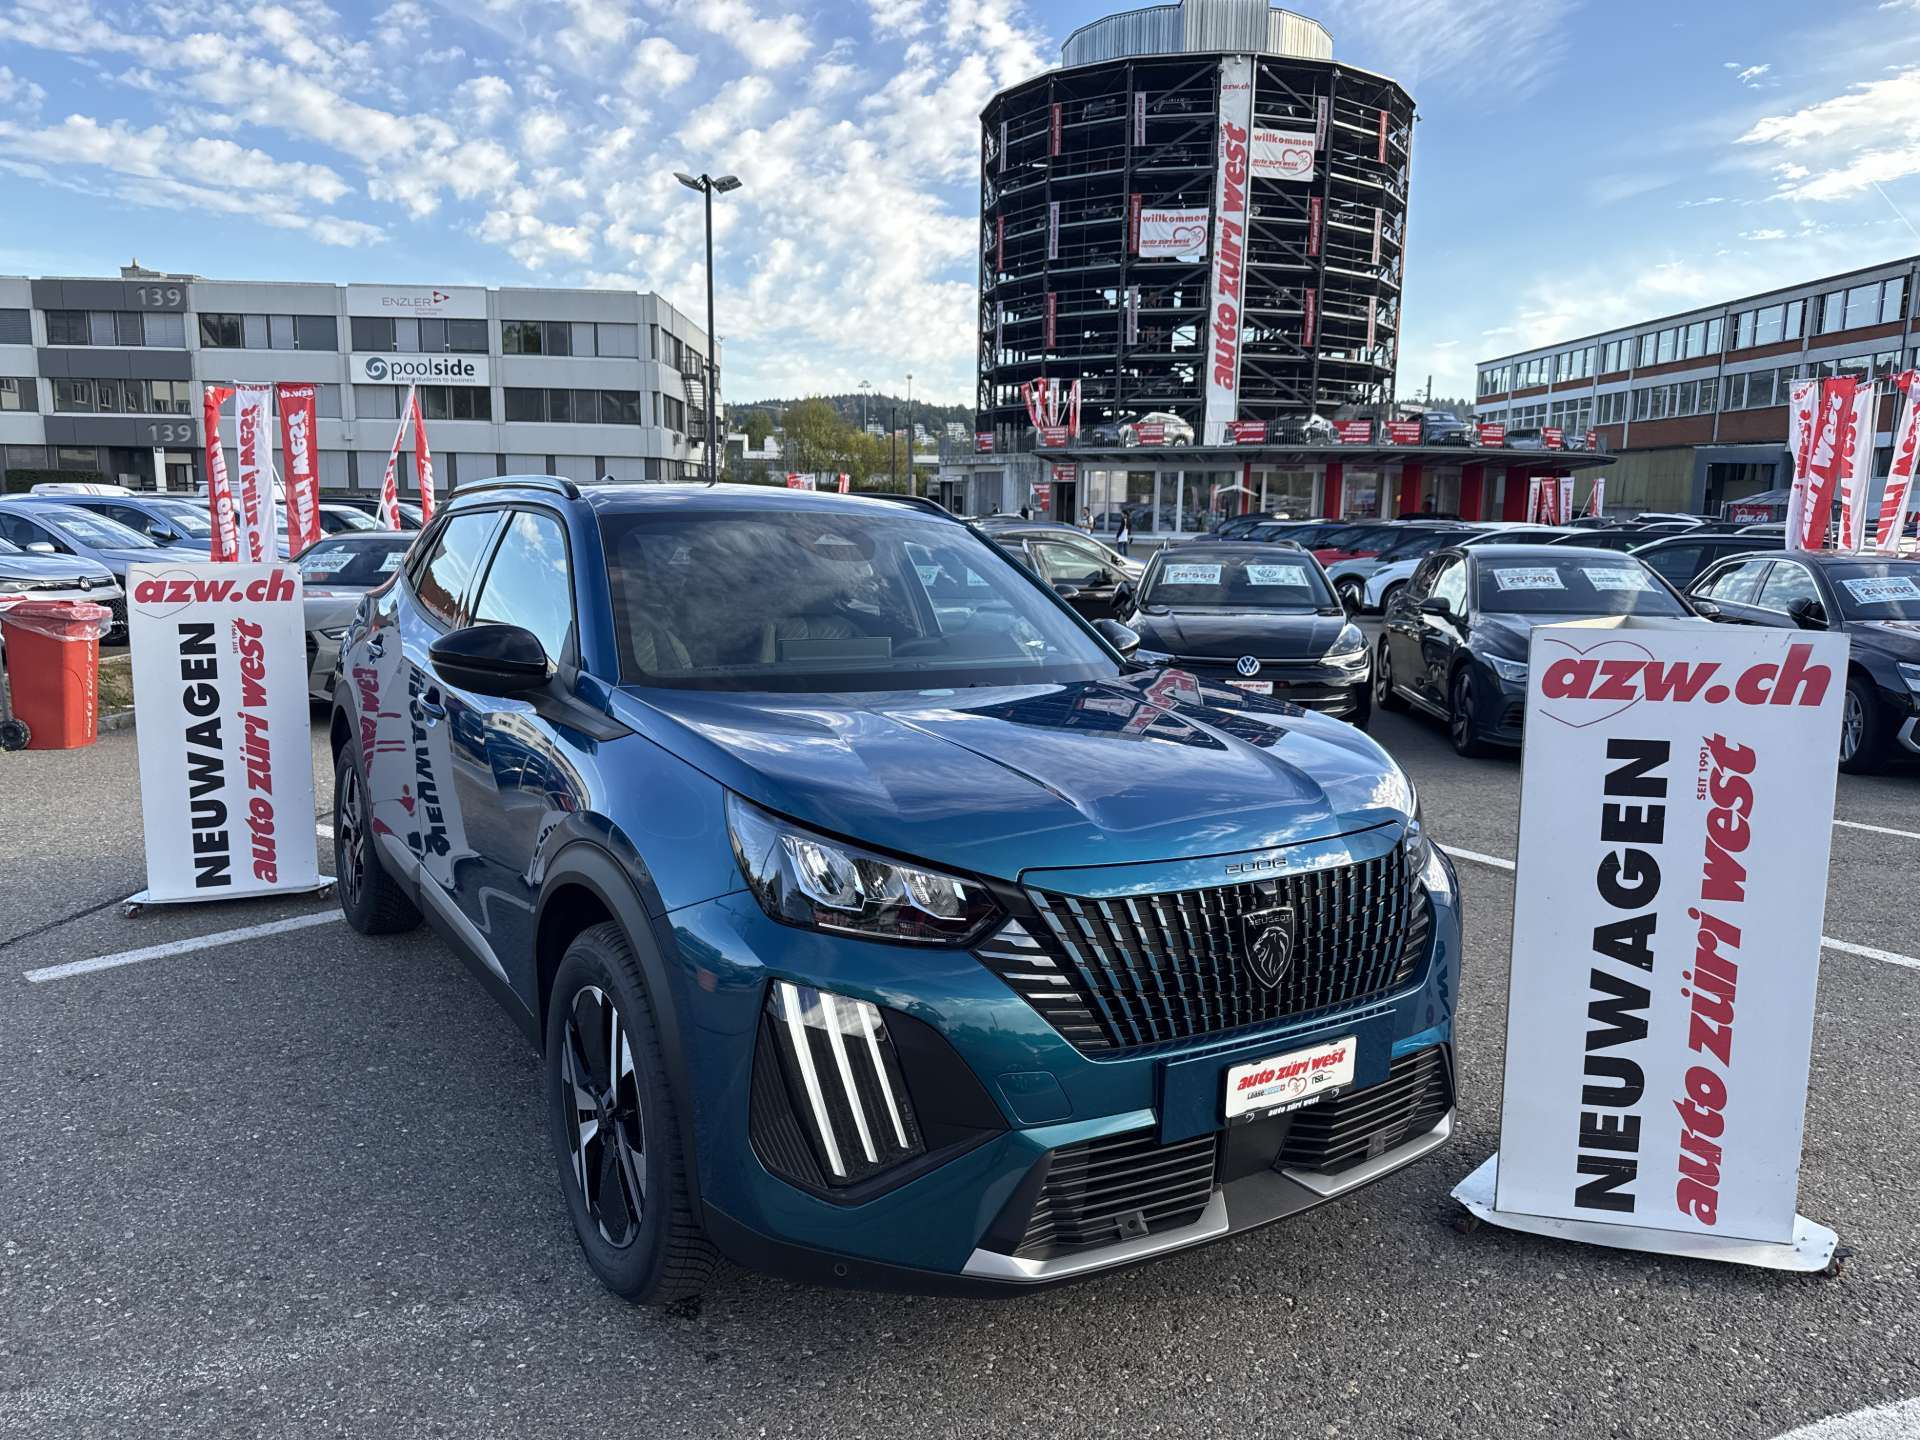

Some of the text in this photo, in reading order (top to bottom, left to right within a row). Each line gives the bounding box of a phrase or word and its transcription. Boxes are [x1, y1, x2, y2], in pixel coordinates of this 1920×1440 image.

[1254, 132, 1314, 147] willkommen
[1142, 213, 1207, 223] willkommen
[1213, 121, 1247, 391] auto züri west
[136, 287, 182, 306] 139
[382, 297, 432, 307] ENZLER
[391, 358, 475, 381] poolside
[148, 424, 192, 442] 139
[134, 569, 296, 604] azw.ch
[1541, 644, 1832, 707] azw.ch
[178, 622, 232, 888] NEUWAGEN
[231, 617, 278, 884] auto züri west
[1696, 746, 1709, 801] SEIT 1991
[1225, 858, 1288, 875] 2008
[1574, 738, 1671, 1213] NEUWAGEN
[1672, 732, 1757, 1227] auto züri west
[1237, 1068, 1275, 1091] auto
[1276, 1056, 1311, 1081] züri
[1312, 1048, 1346, 1071] west
[1268, 1096, 1320, 1117] auto züri west
